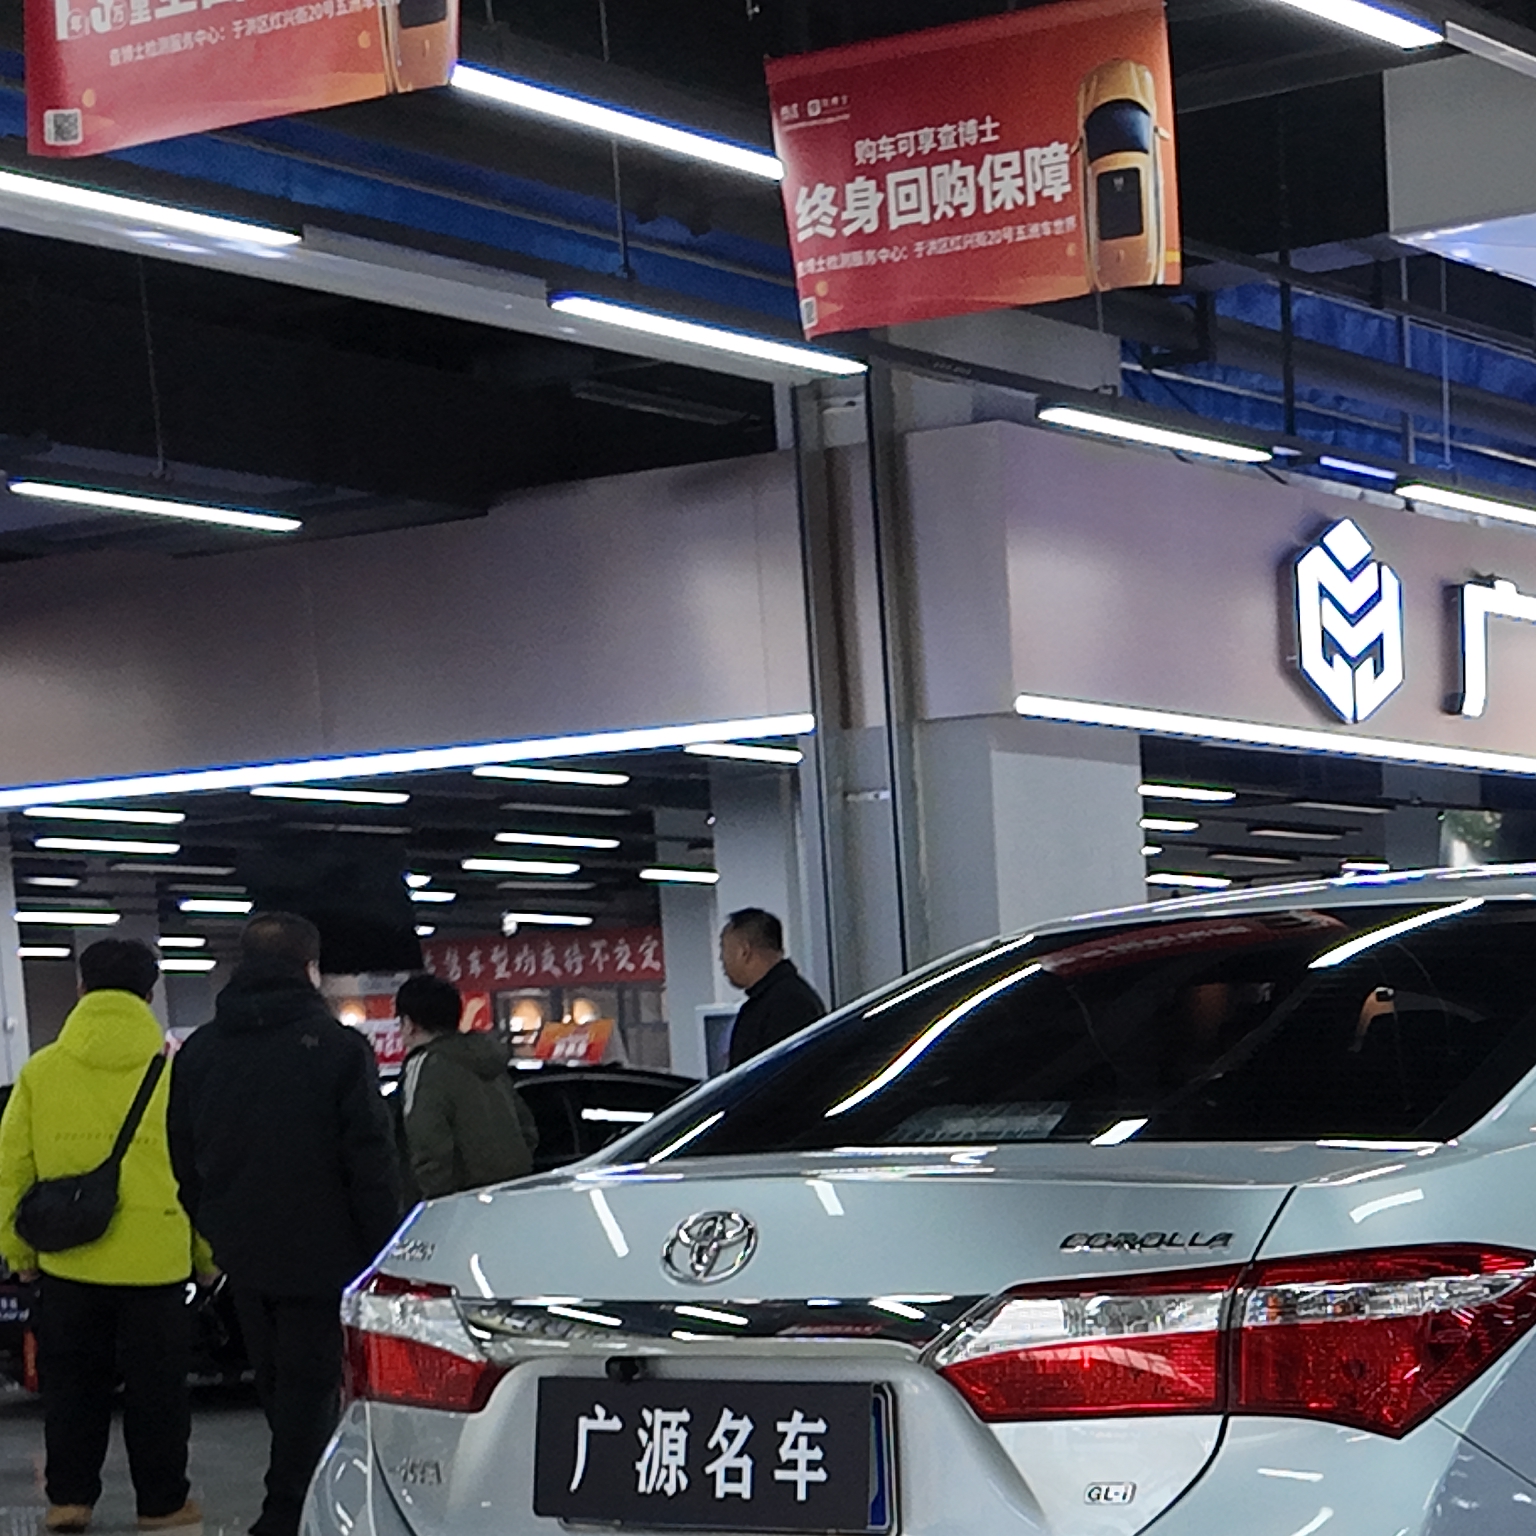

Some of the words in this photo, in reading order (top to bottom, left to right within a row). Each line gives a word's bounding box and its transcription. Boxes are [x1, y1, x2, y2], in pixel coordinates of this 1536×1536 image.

[854, 115, 1001, 166] 购车可享查博士
[796, 141, 1074, 242] 终身回购保障
[1060, 1231, 1235, 1252] COROLLA
[570, 1404, 829, 1501] 广源名车
